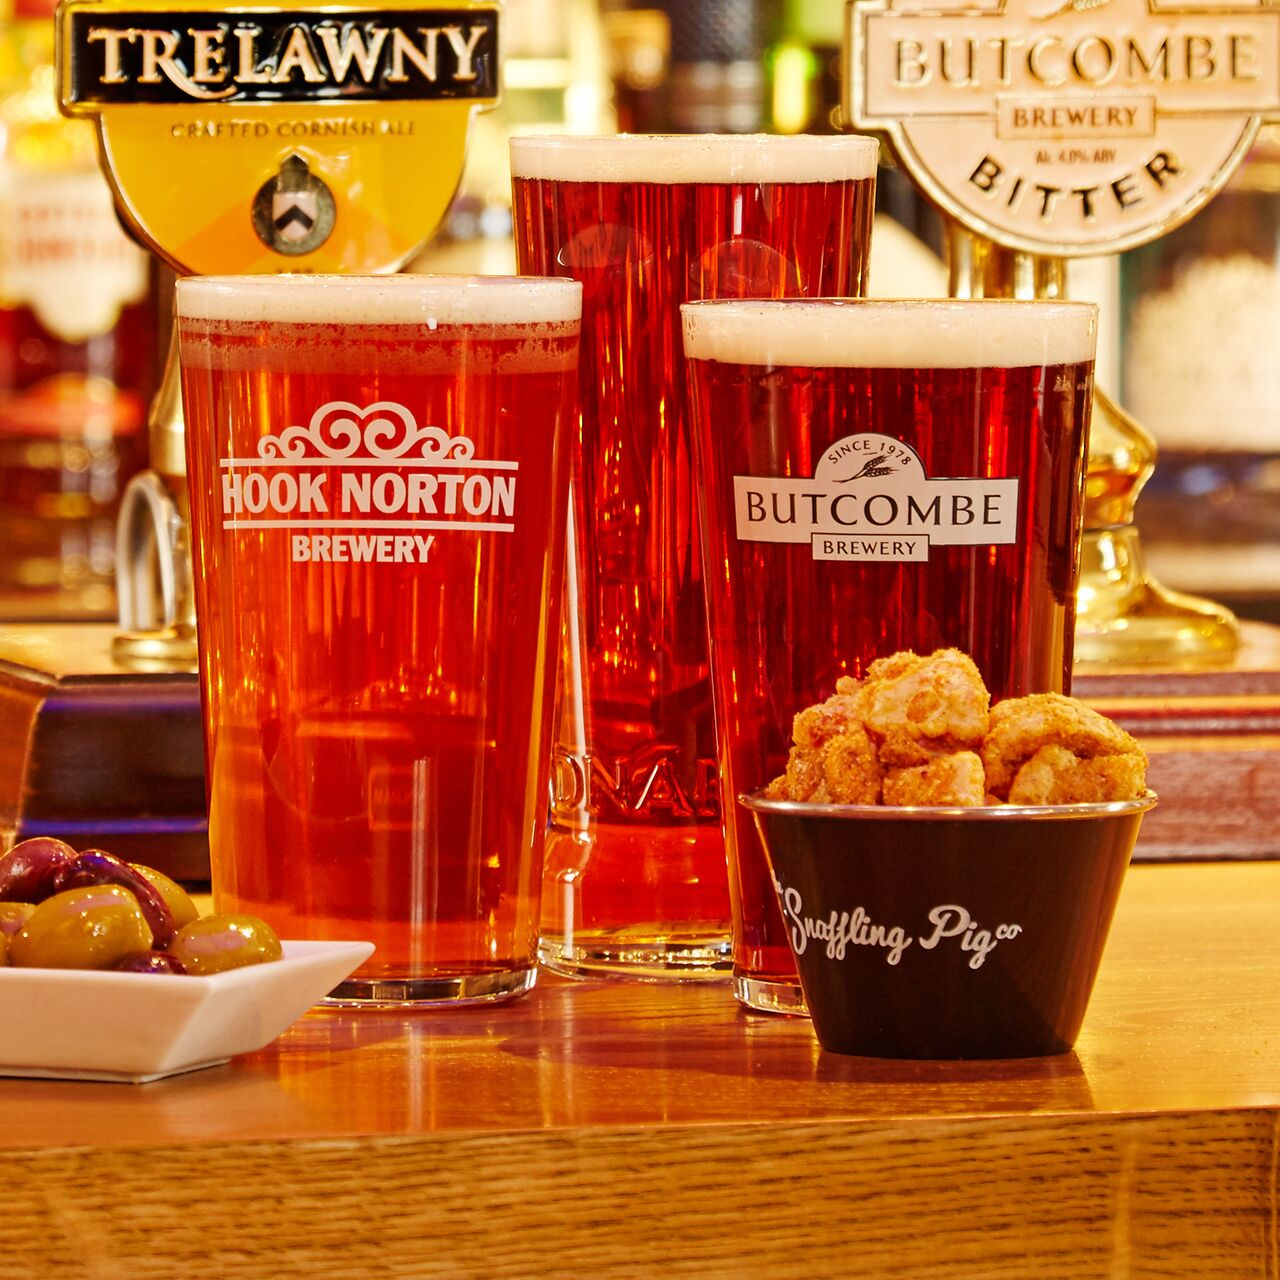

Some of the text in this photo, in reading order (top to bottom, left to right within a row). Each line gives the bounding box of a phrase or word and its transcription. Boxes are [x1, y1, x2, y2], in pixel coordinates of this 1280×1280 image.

[88, 26, 488, 100] TRELAWNY
[896, 33, 1261, 87] BUTCOMBE
[171, 121, 416, 138] CRAFTED CORNISH ALE
[1014, 107, 1138, 129] BREWERY
[1093, 150, 1117, 164] ABV
[968, 150, 1186, 222] BITTER
[828, 440, 912, 465] SINCE 1978
[221, 472, 516, 517] HOOK NORTON
[746, 491, 1002, 526] BUTCOMBE
[292, 535, 435, 563] BREWERY
[823, 540, 918, 556] BREWERY
[784, 887, 913, 966] Snaffling
[919, 905, 998, 970] Pig
